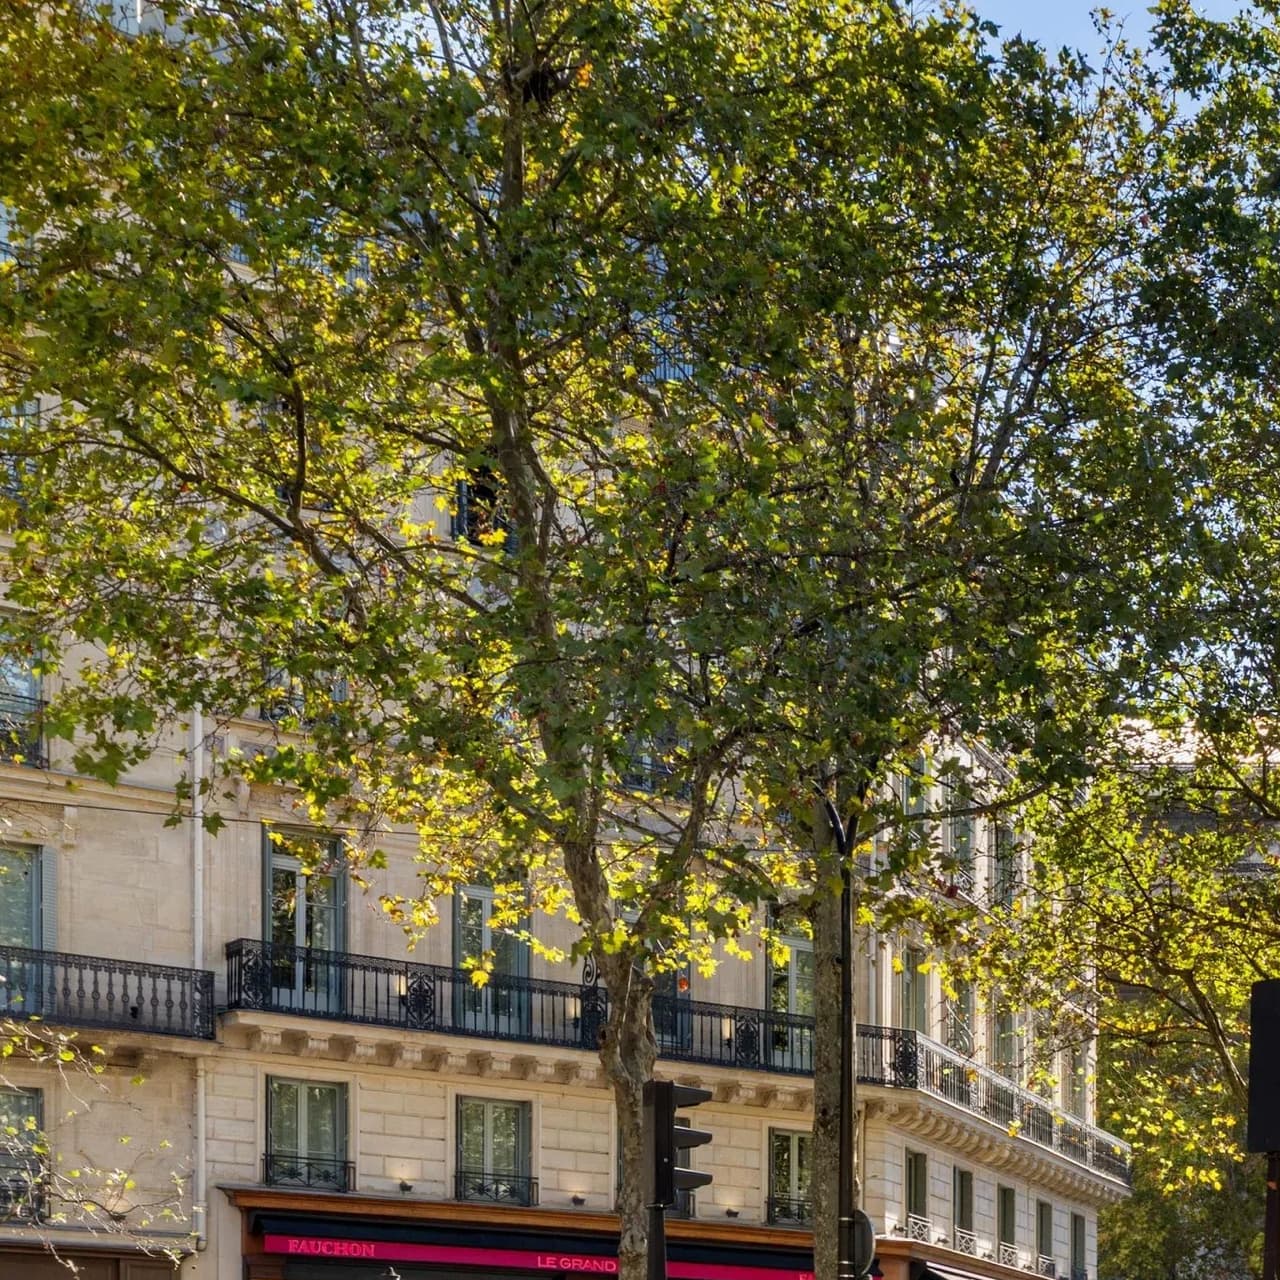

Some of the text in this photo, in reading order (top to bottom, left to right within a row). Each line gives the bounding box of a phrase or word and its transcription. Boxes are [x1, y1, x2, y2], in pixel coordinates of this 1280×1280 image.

[288, 1239, 375, 1257] FAUCHON
[537, 1256, 617, 1272] LE GRAND
